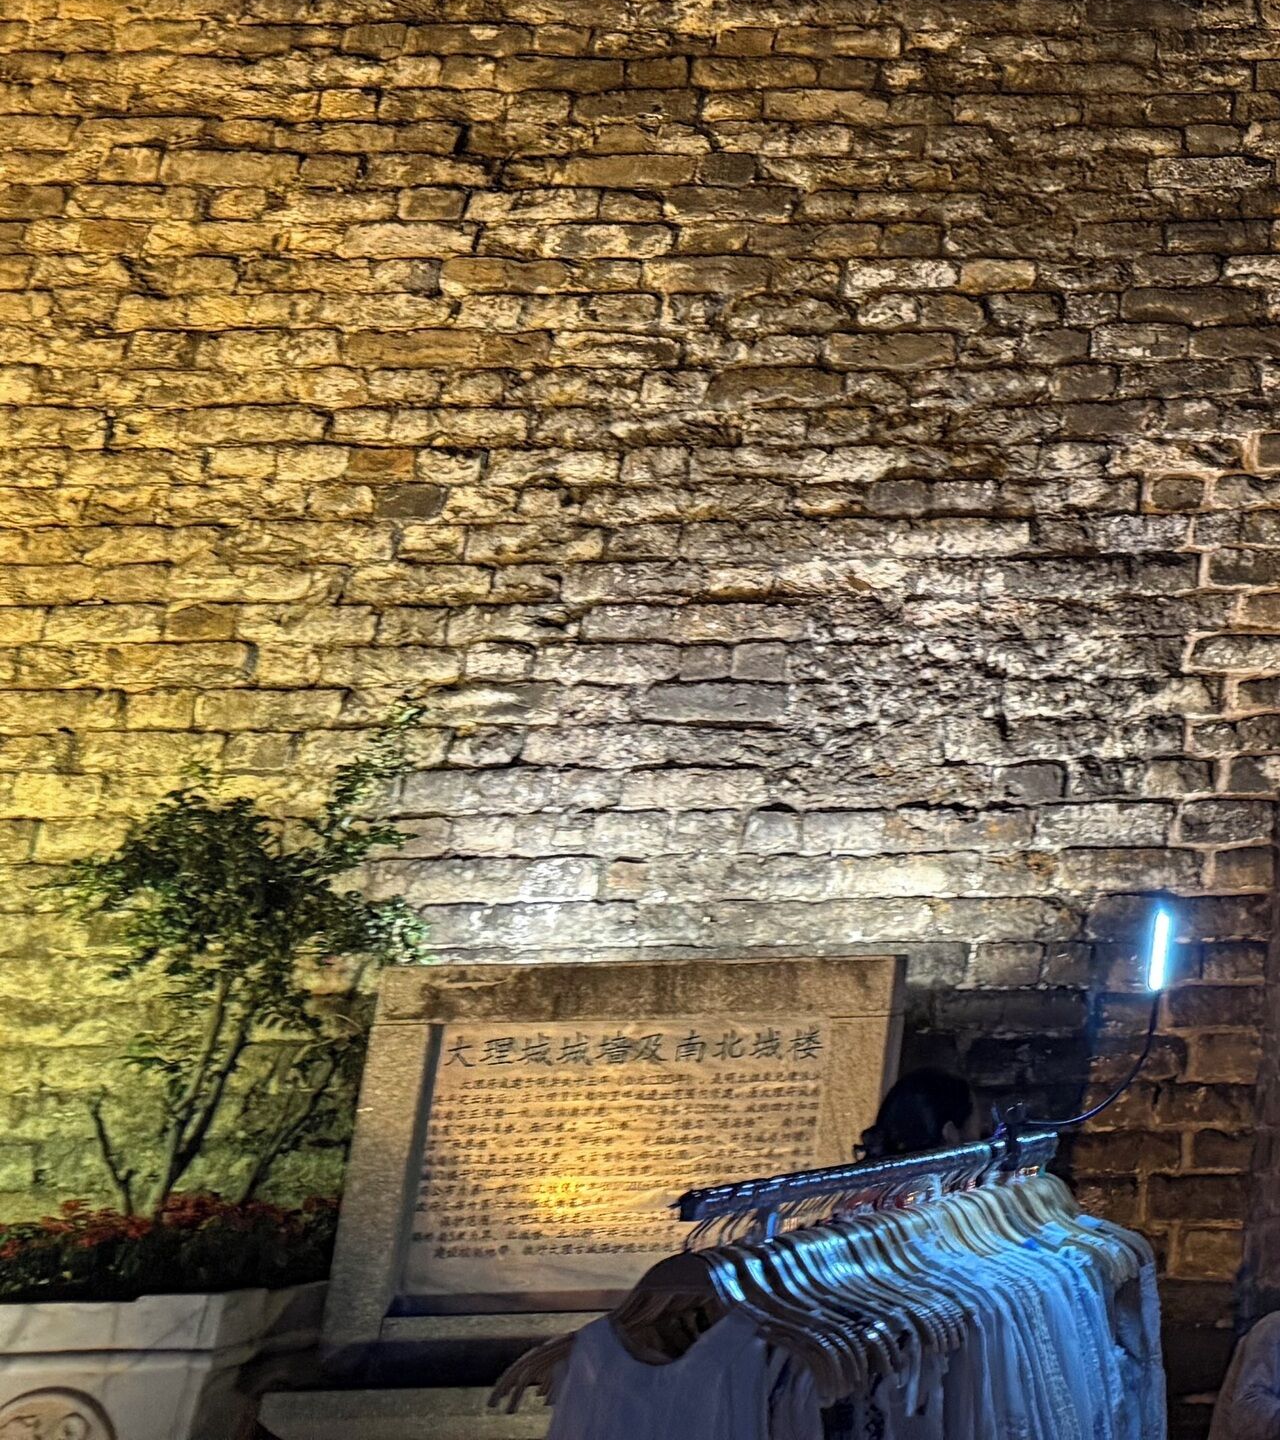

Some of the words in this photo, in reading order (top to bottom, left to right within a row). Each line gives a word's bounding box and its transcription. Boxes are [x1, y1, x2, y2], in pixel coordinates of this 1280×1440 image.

[444, 1027, 825, 1068] 大理城城墙及南北城楼
